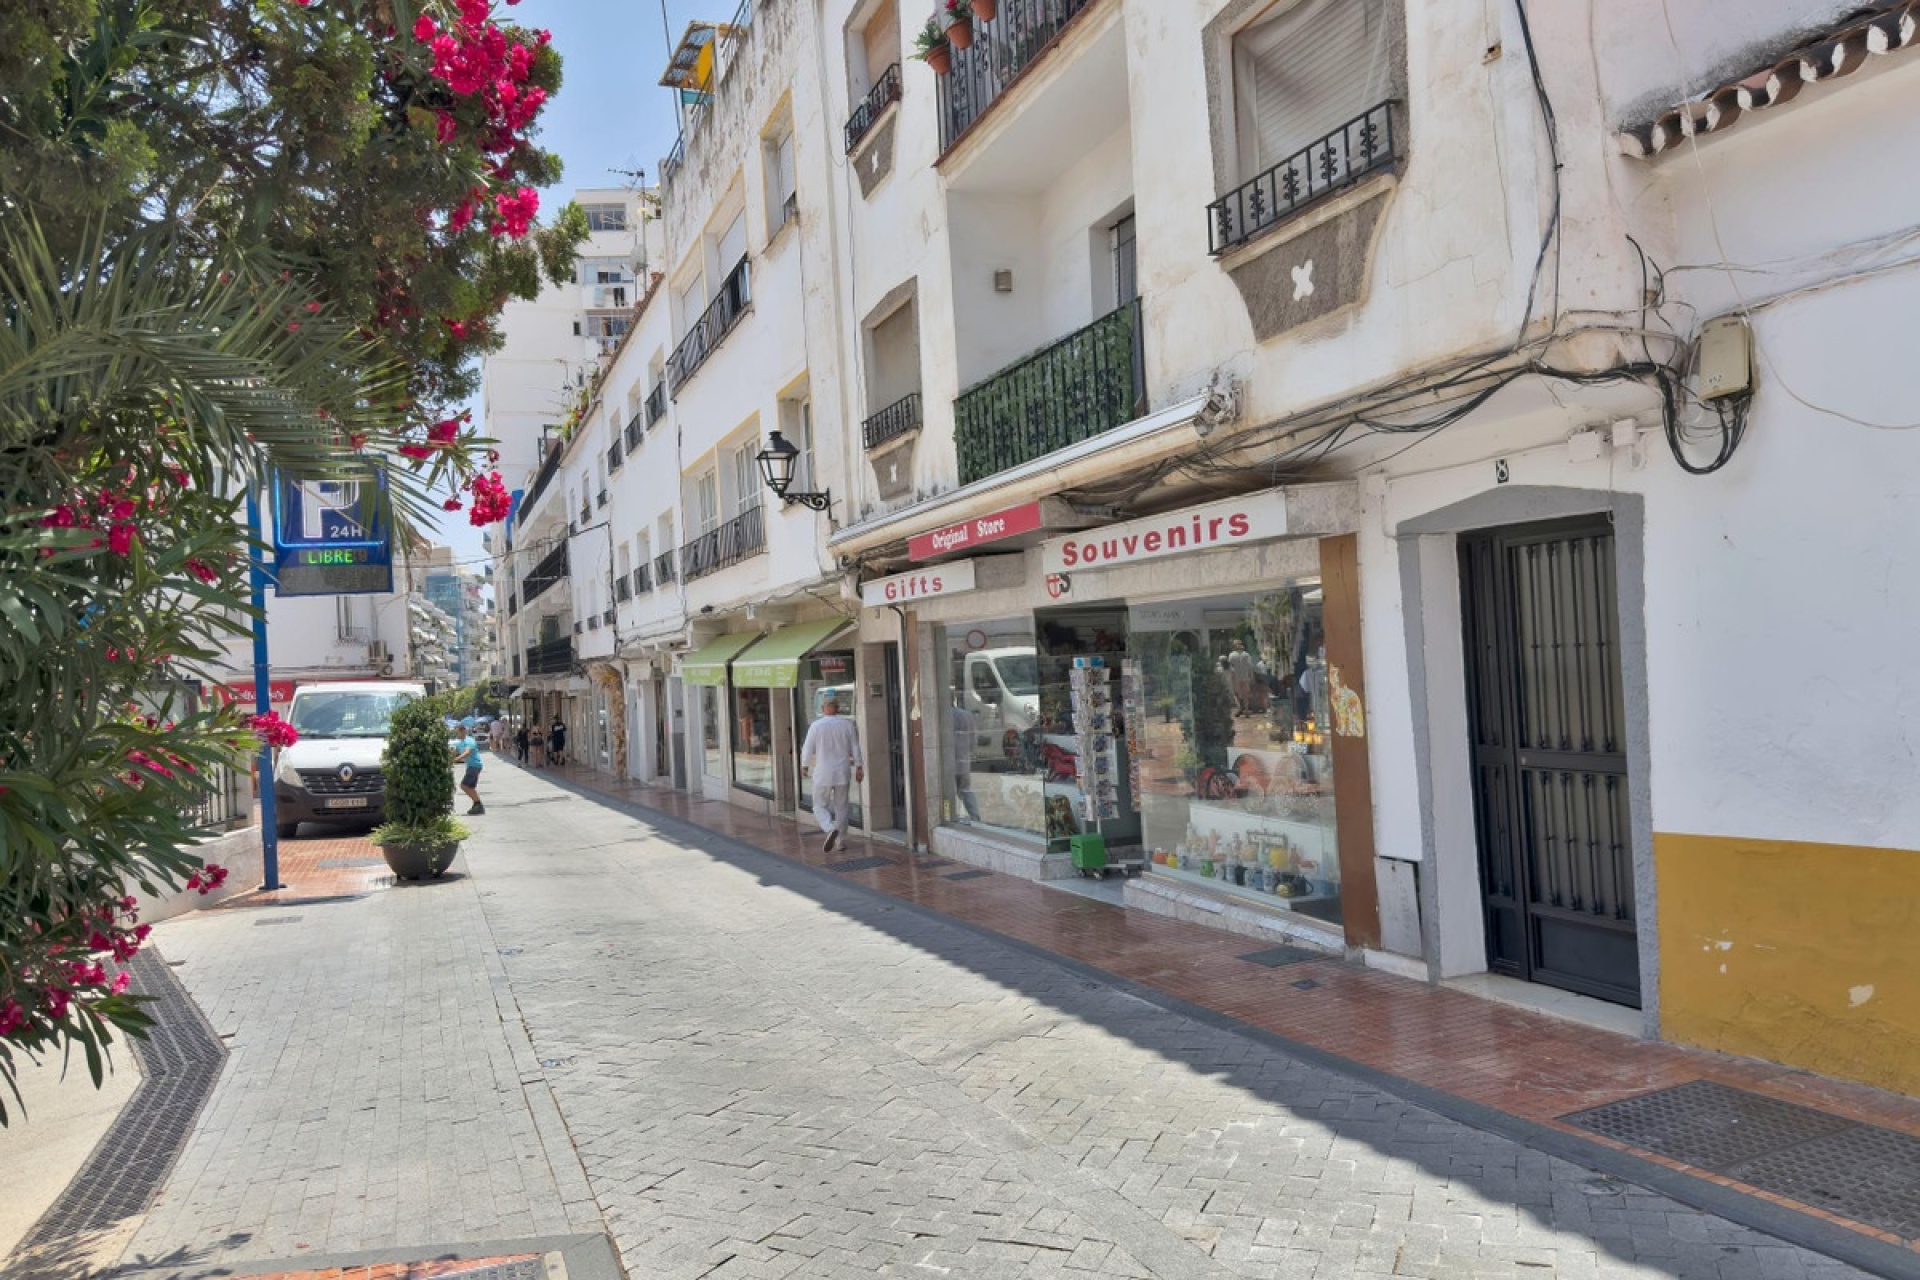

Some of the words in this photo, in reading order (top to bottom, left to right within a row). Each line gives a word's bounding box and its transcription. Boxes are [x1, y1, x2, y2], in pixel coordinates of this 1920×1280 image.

[1497, 458, 1508, 481] 8
[301, 477, 360, 539] P
[932, 524, 969, 550] Original
[977, 518, 1005, 537] Store
[1062, 512, 1250, 567] Souvenirs
[308, 549, 353, 564] LIBRE
[884, 576, 943, 600] Gifts
